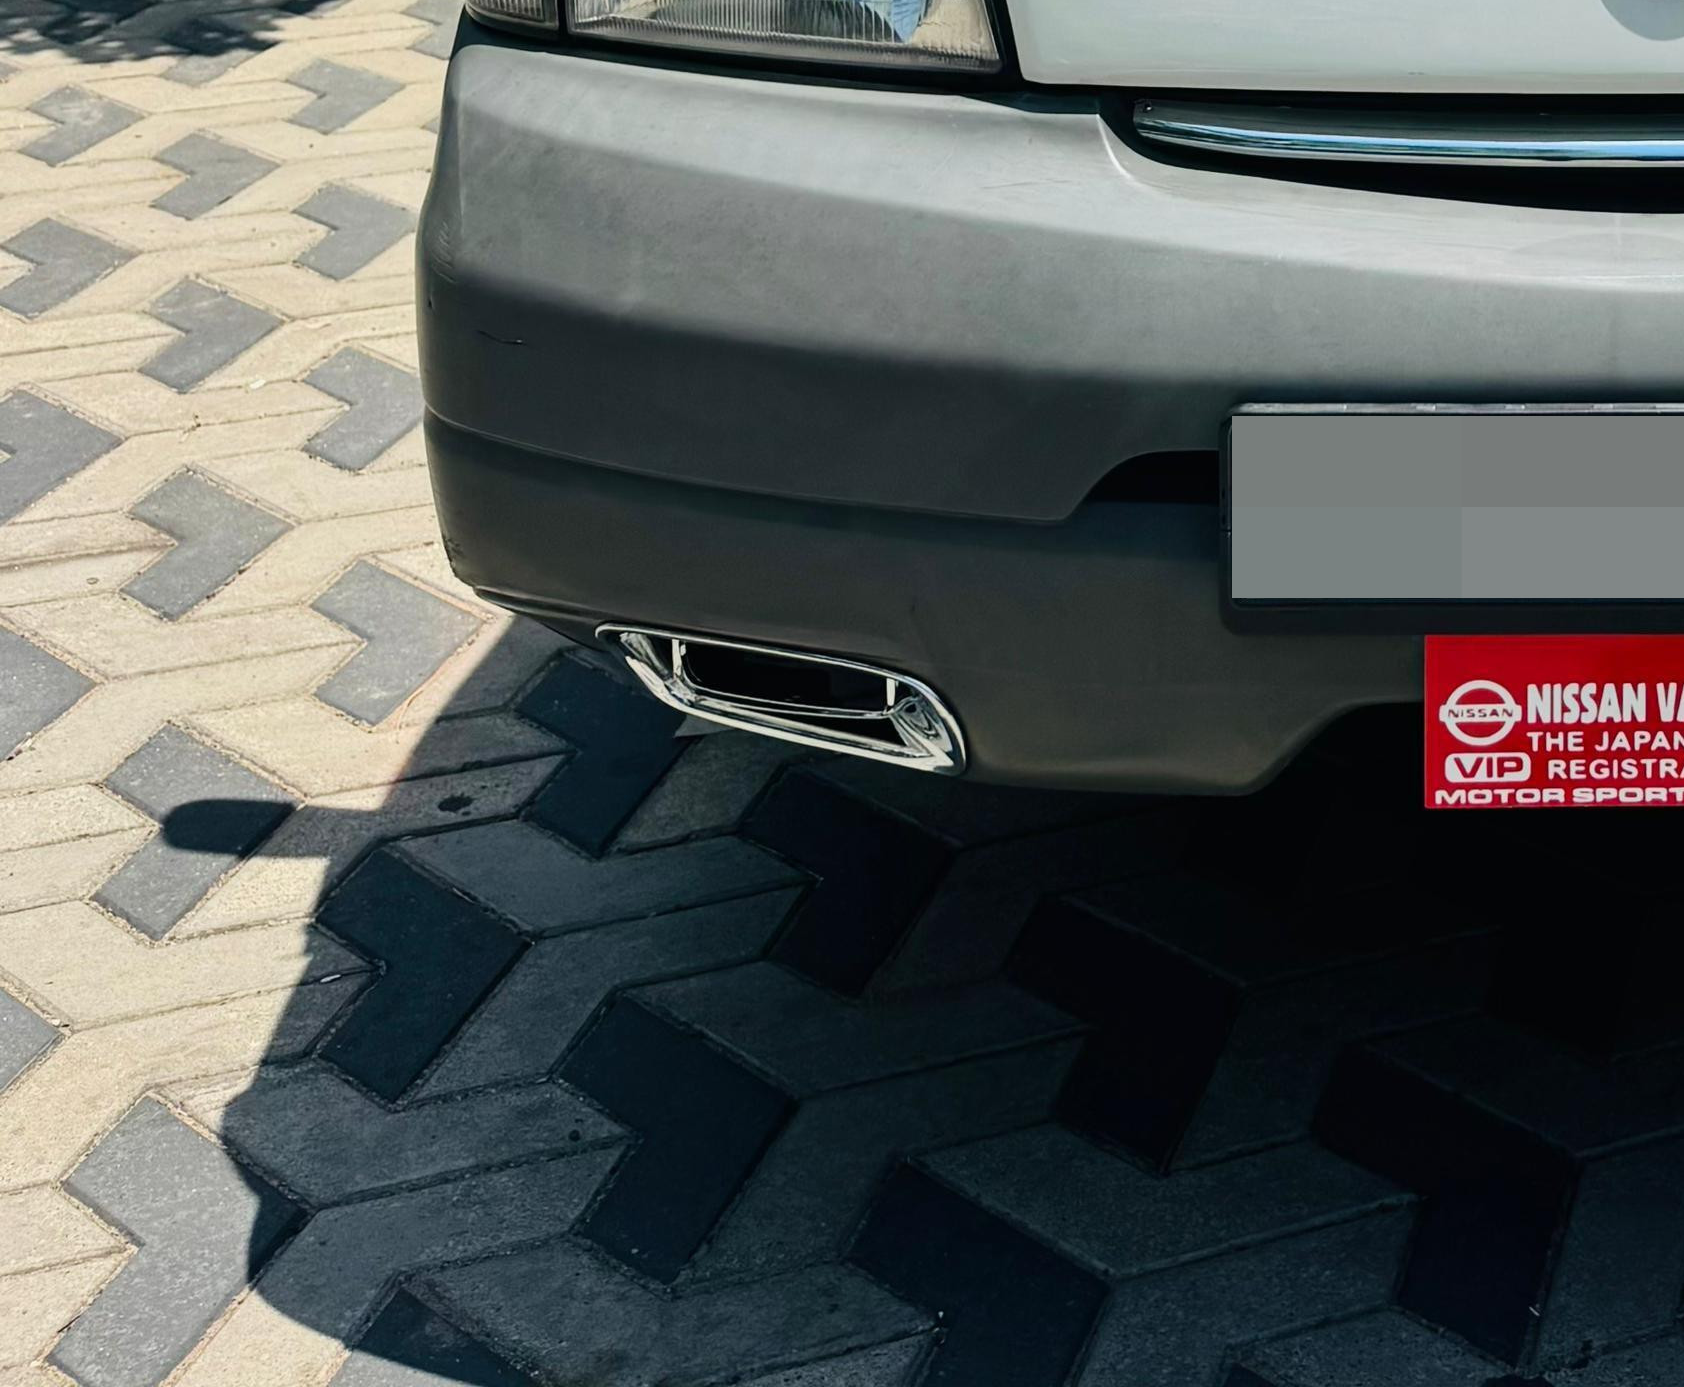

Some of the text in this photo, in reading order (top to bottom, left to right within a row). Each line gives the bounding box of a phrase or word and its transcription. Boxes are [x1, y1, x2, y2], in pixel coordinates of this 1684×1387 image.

[1448, 708, 1514, 718] NISSAN
[1527, 683, 1647, 724] NISSAN
[1527, 731, 1585, 752] THE
[1454, 756, 1525, 779] VIP
[1435, 788, 1566, 805] MOTOR
